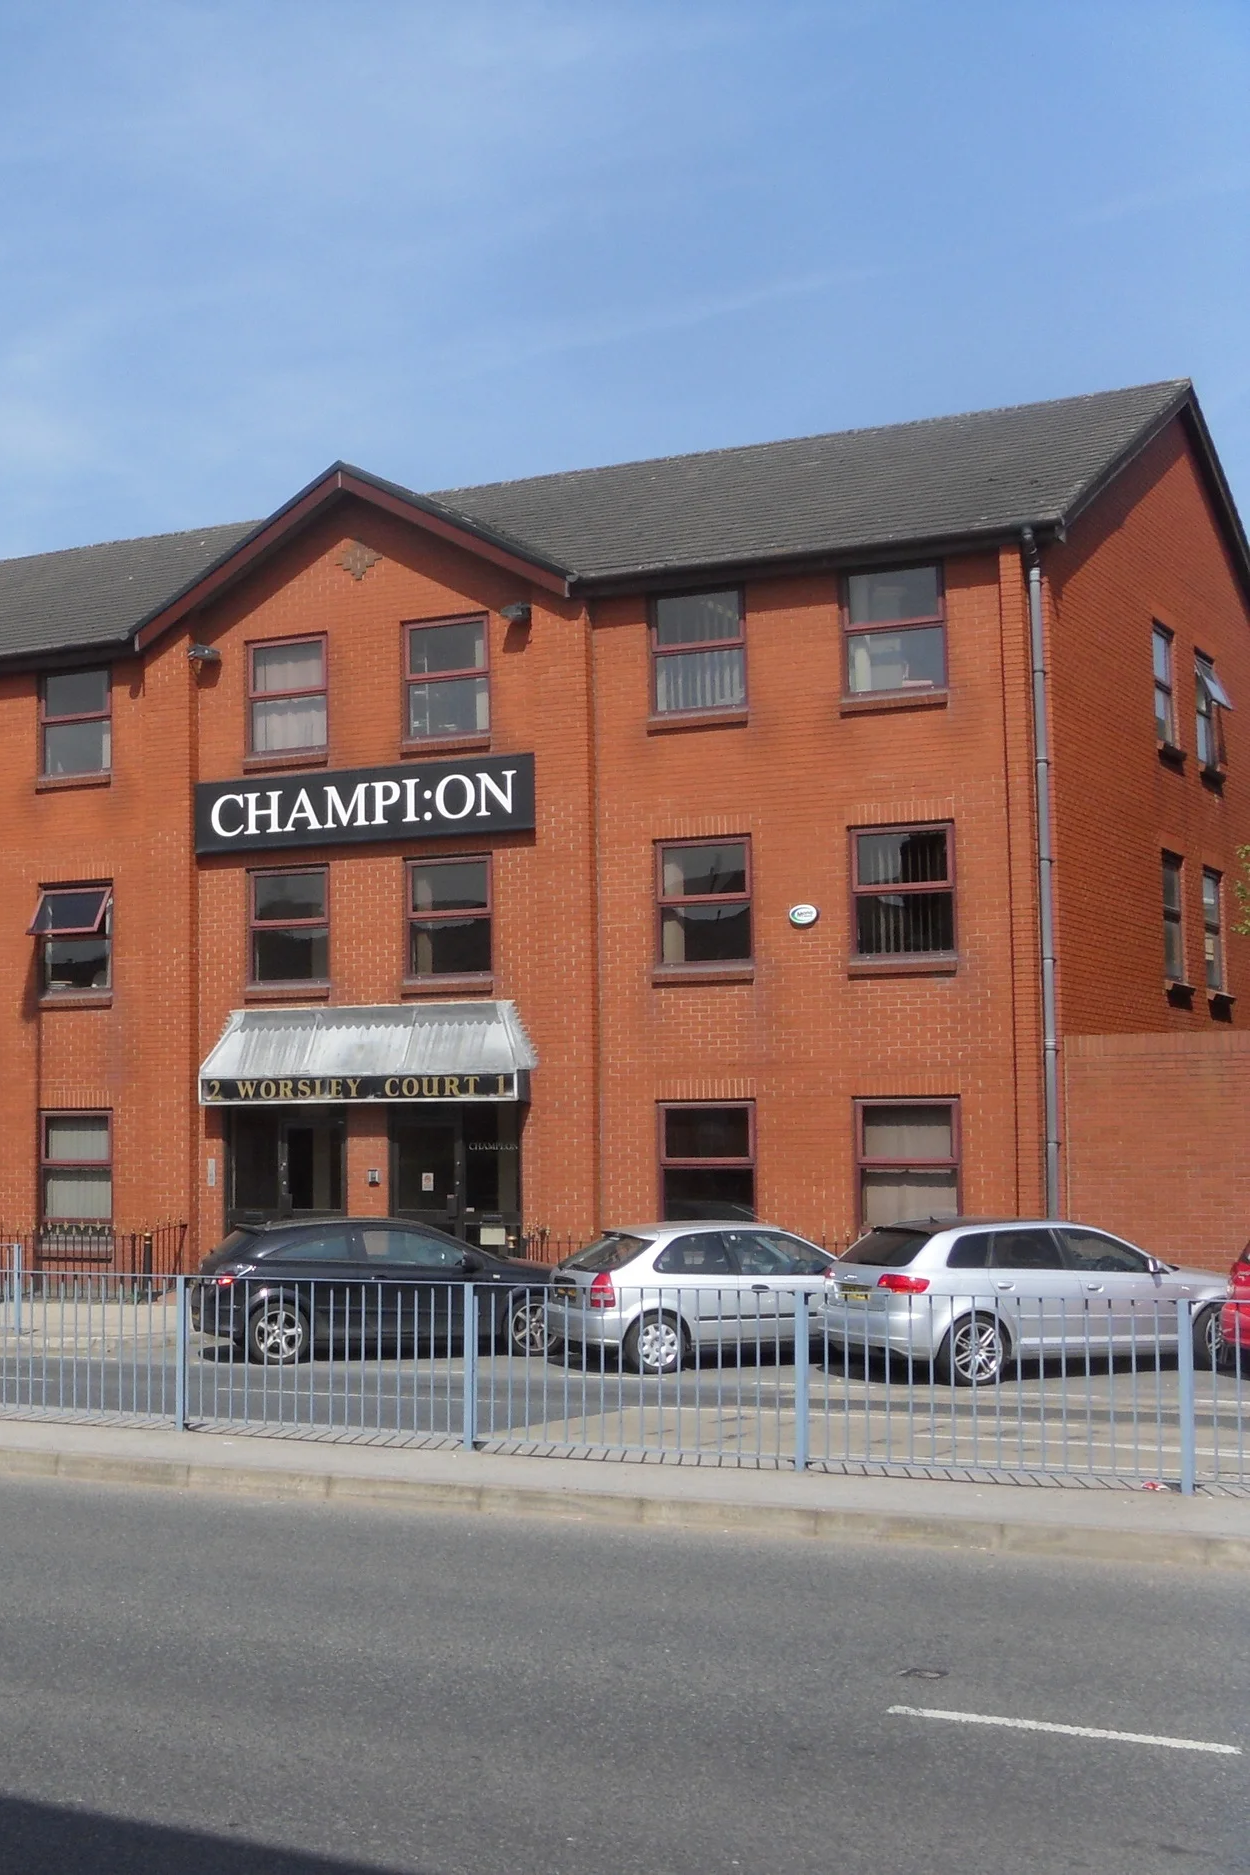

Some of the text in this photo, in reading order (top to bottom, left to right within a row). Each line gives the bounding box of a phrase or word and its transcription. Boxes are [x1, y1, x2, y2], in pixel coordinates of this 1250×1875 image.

[210, 769, 518, 838] CHAMPI:ON
[209, 1075, 506, 1100] 2 WORSLEY COURT 1
